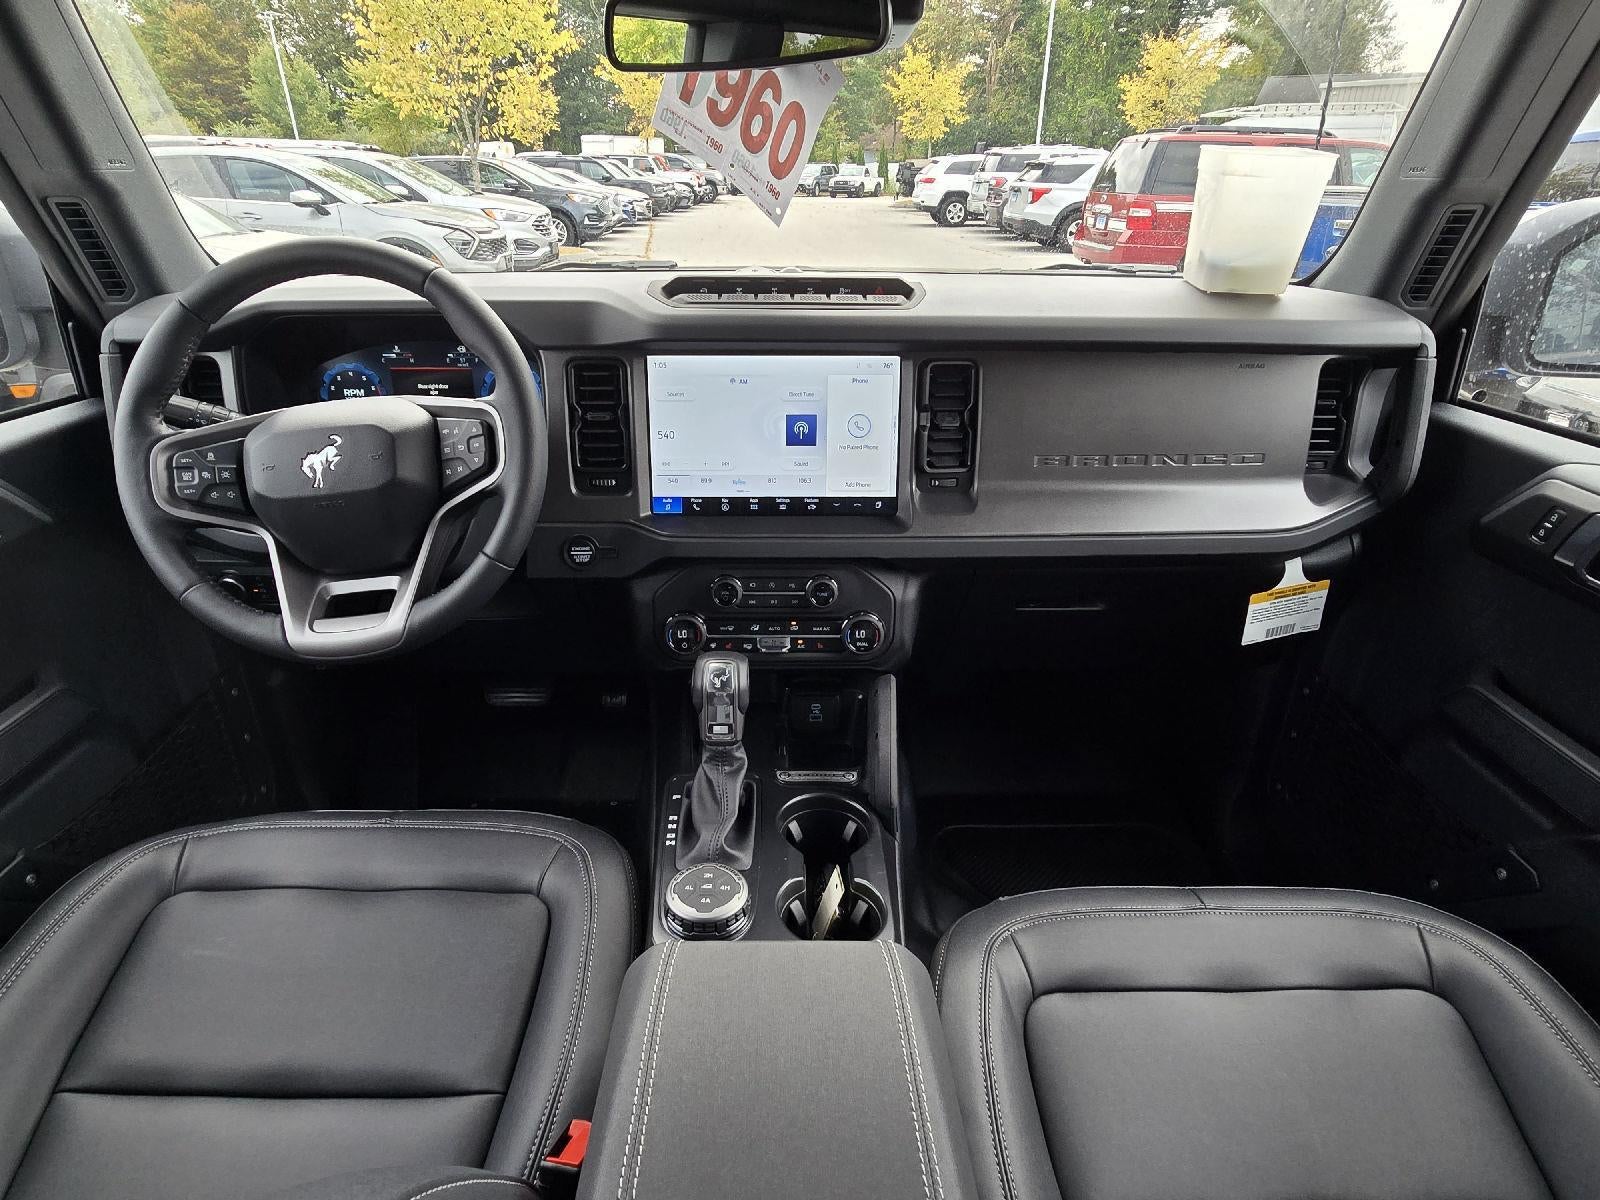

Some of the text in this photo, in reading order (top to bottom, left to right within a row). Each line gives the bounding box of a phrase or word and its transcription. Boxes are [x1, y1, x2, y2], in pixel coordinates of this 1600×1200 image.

[705, 135, 724, 154] 1960
[765, 180, 781, 201] 1960
[343, 388, 365, 397] RPM
[657, 430, 675, 440] 540
[1033, 453, 1266, 468] BRONCO
[677, 630, 688, 639] LO
[855, 630, 866, 639] LO
